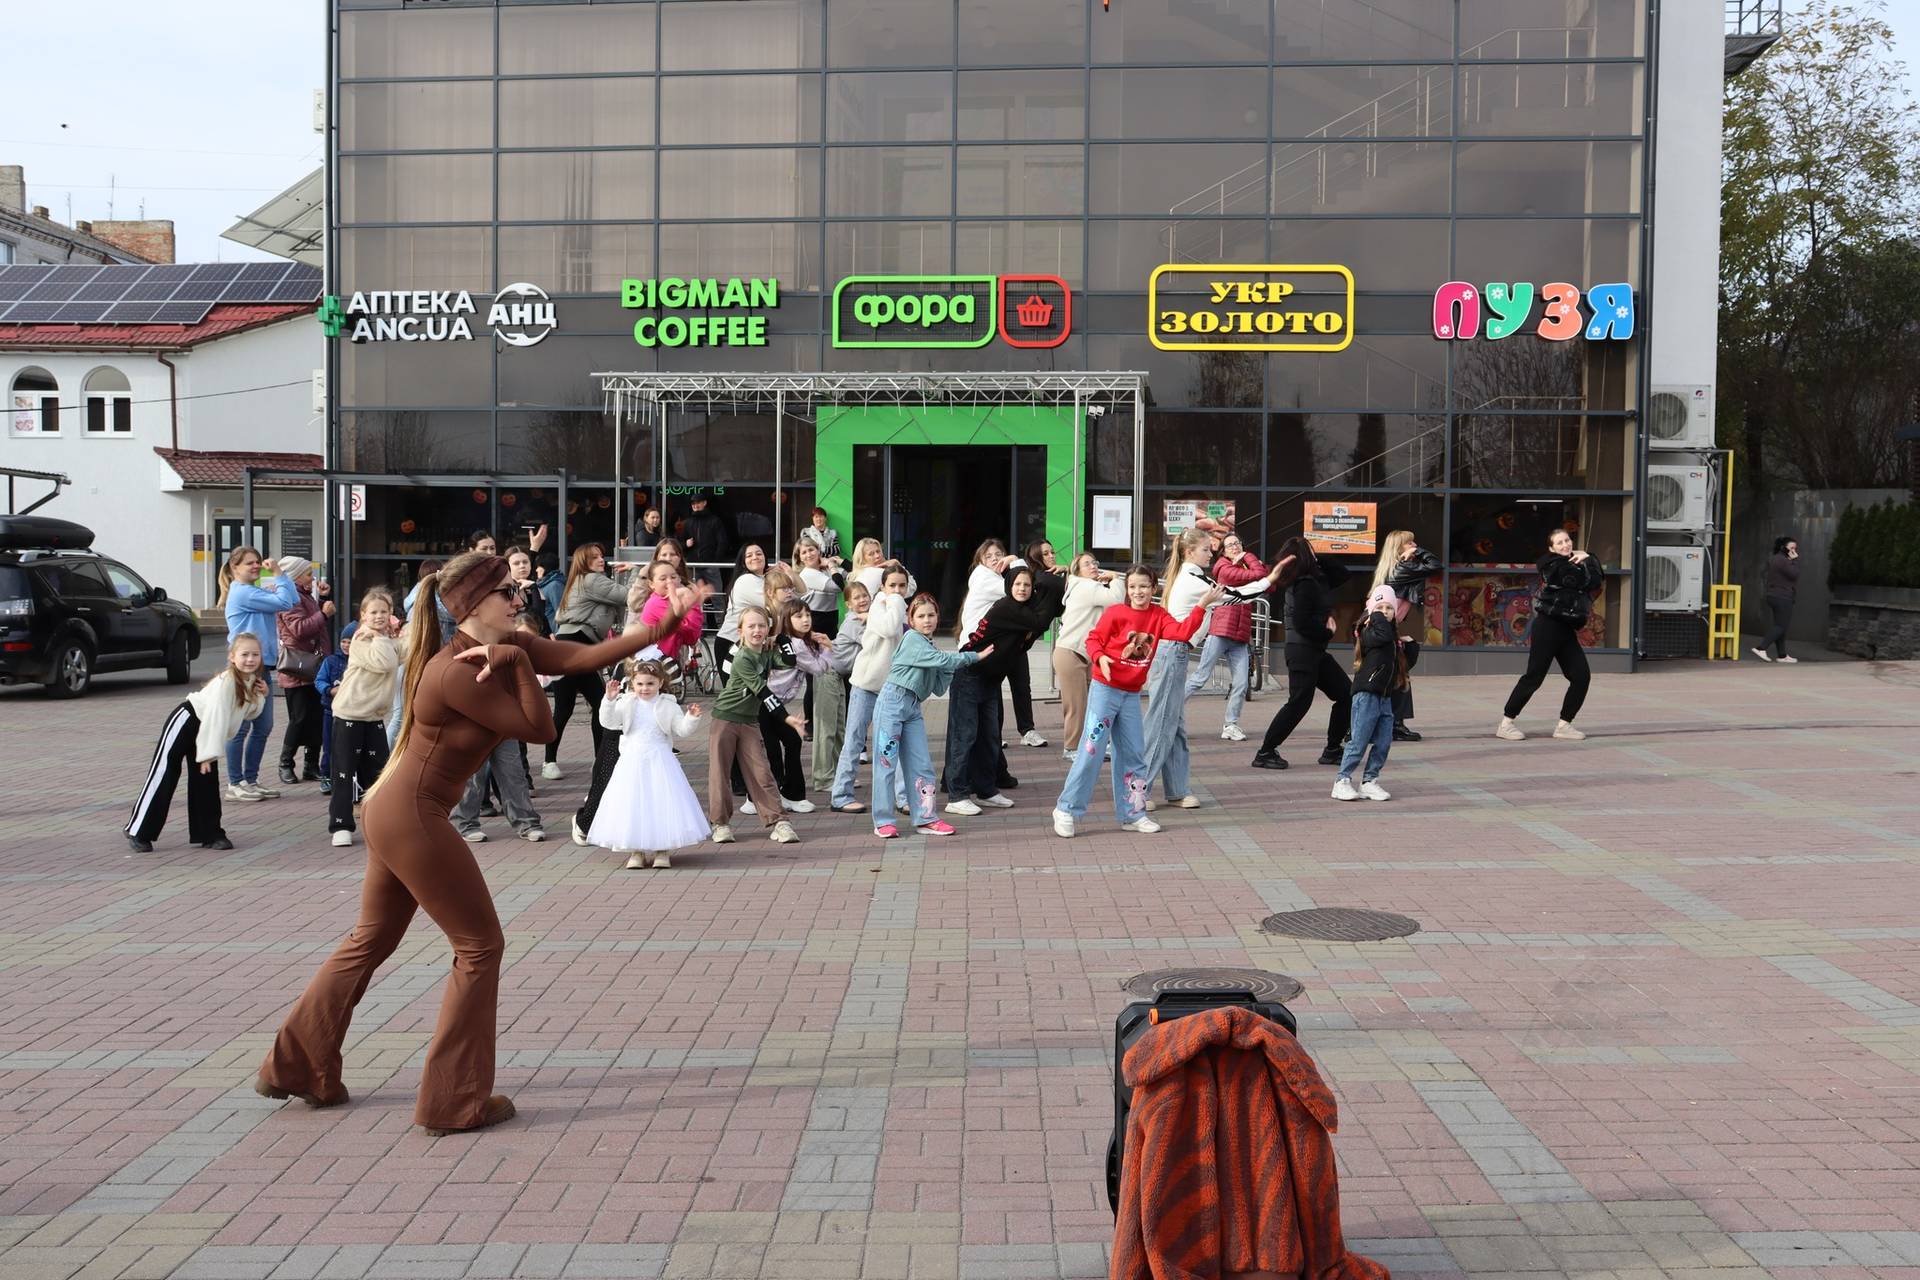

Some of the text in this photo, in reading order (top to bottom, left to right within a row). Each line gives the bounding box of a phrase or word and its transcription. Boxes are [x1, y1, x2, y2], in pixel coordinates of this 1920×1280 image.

[346, 290, 476, 314] АПТЕКА
[621, 278, 777, 308] BIGMAN
[1210, 281, 1294, 304] УКР
[487, 303, 557, 328] АНЦ
[854, 294, 975, 327] фора
[1160, 311, 1343, 334] ЗОЛОТО
[1433, 281, 1635, 341] ПУЗЯ
[351, 317, 474, 341] ANC.UA
[633, 316, 766, 347] COFFEE
